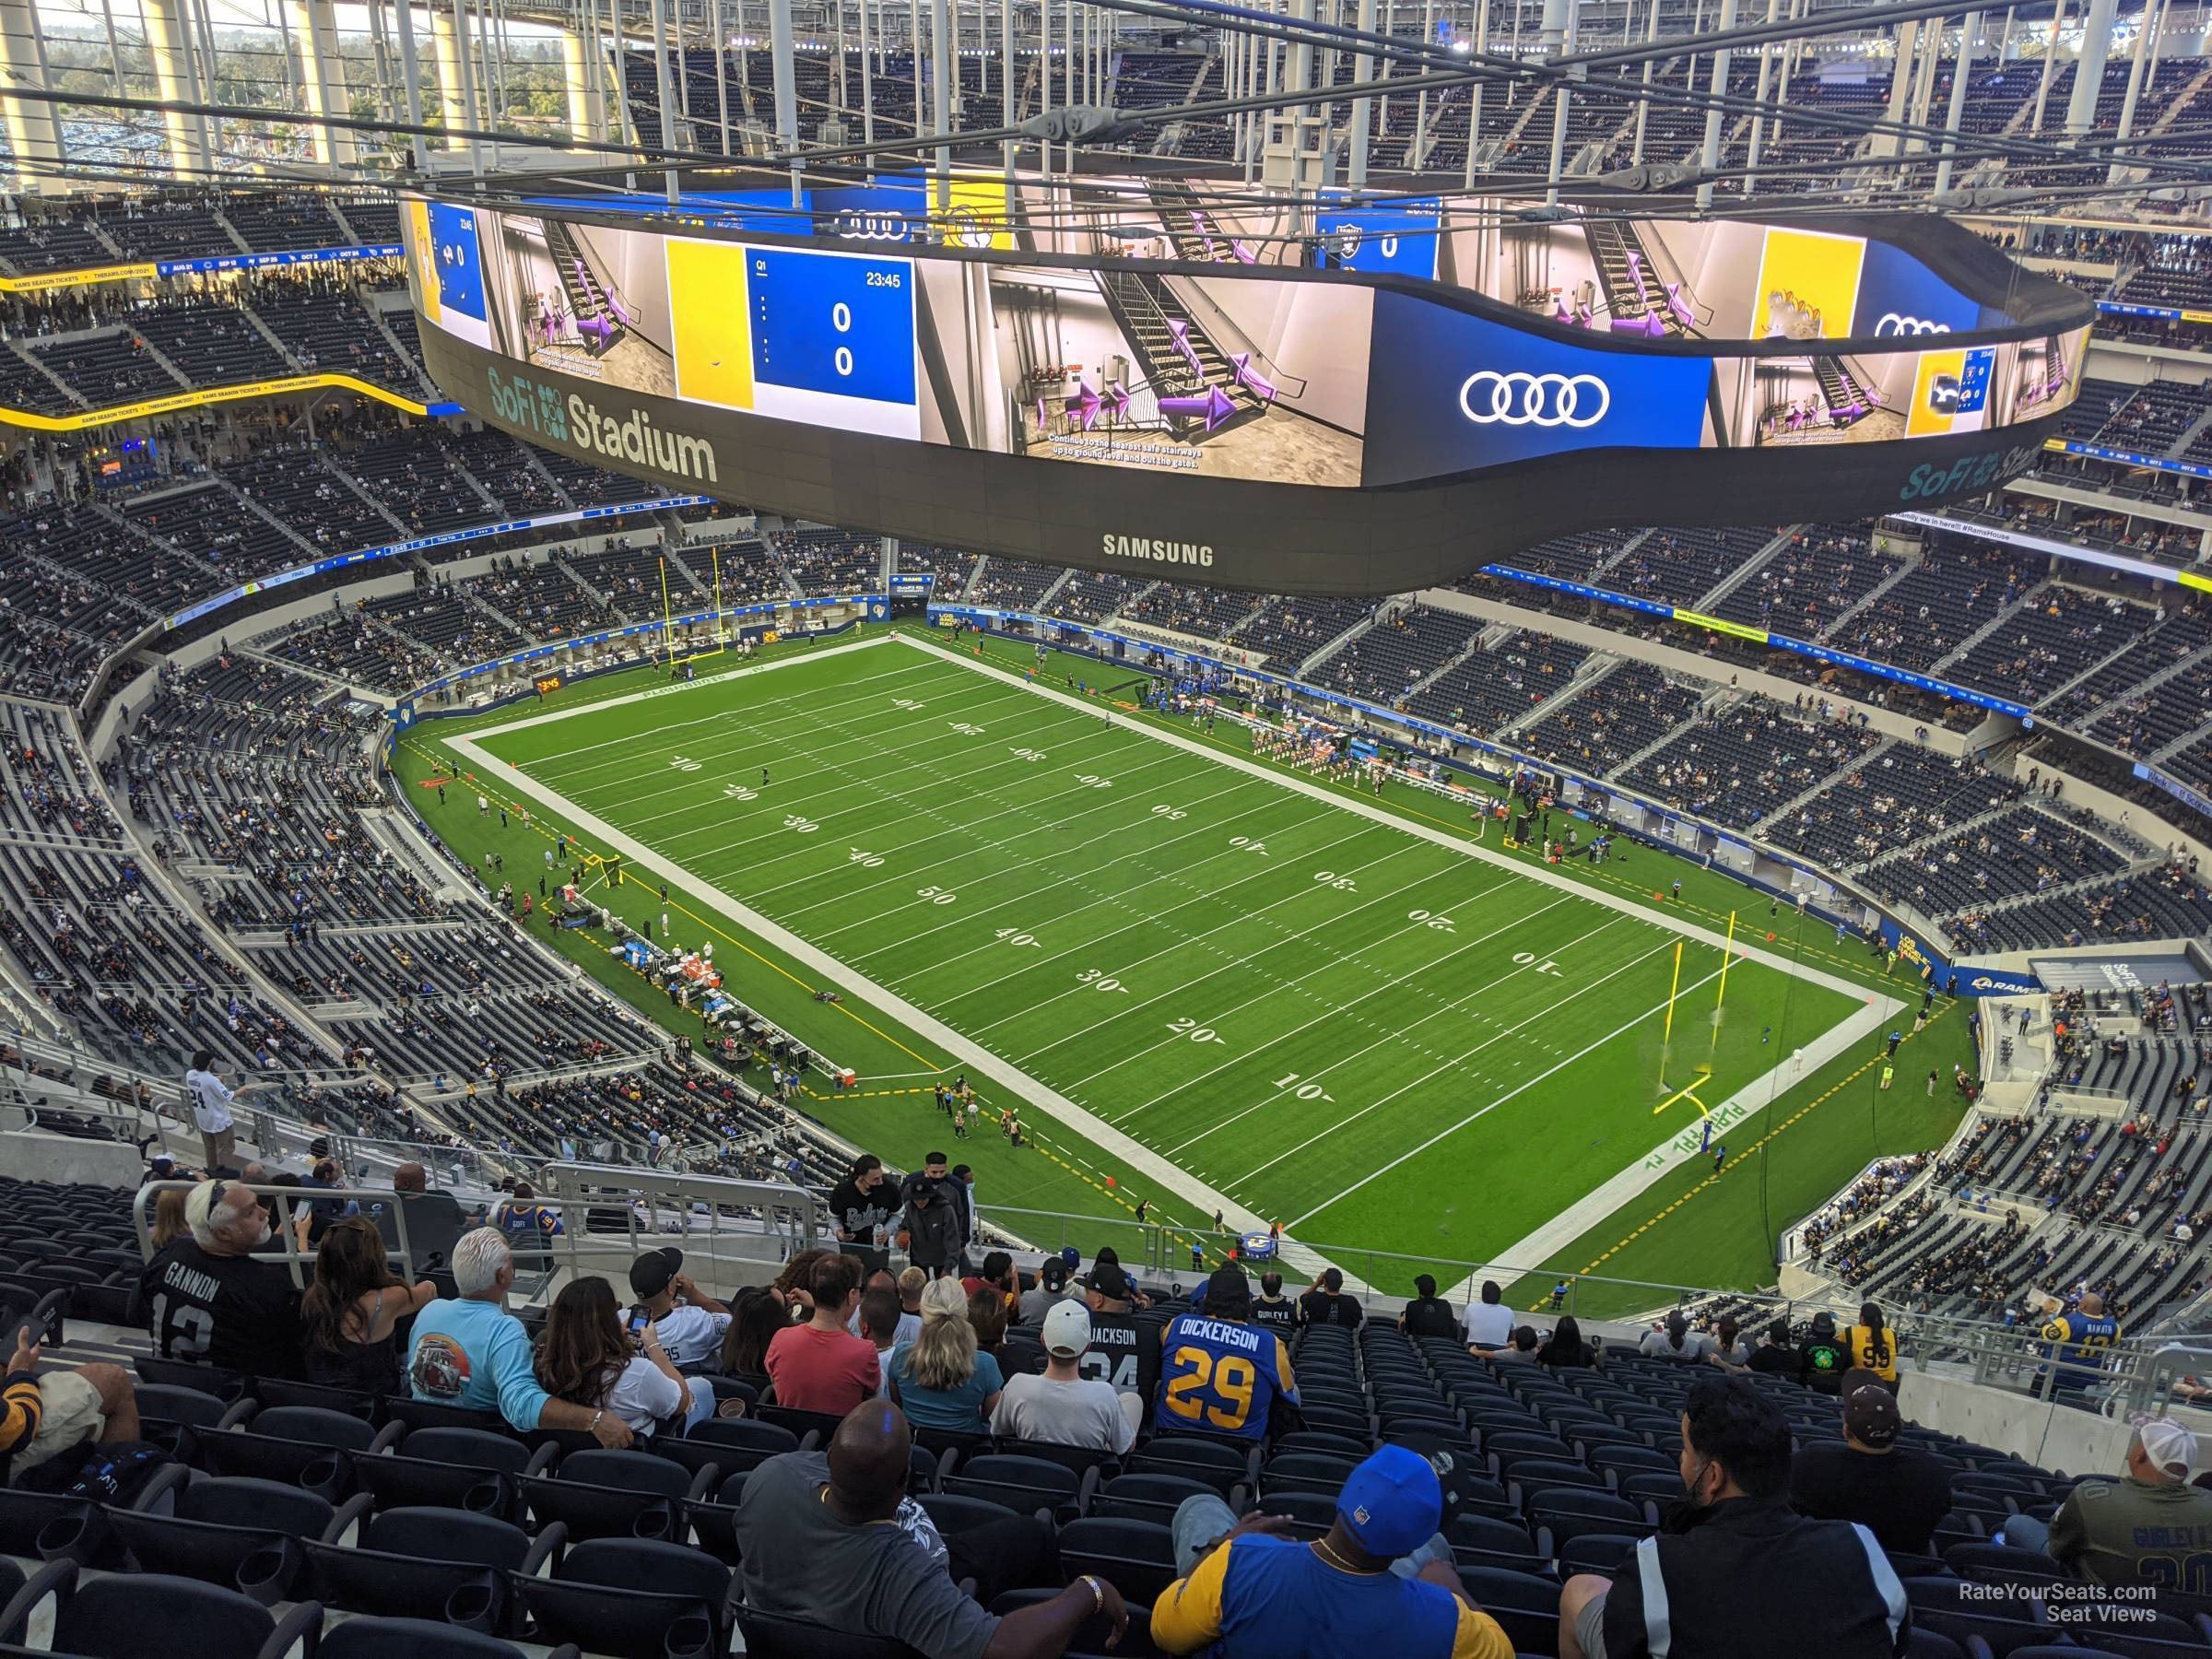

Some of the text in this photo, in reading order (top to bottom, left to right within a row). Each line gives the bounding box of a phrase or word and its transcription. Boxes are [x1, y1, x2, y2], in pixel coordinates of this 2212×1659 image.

[456, 244, 465, 266] 0
[1382, 233, 1399, 258] 0
[55, 276, 79, 284] TICKETS
[866, 271, 900, 288] 23:45
[832, 302, 851, 333] 0
[835, 347, 853, 376] 0
[488, 367, 717, 482] SoFi Stadium
[1048, 433, 1202, 458] Continue to the nearest safe stairways
[1053, 447, 1064, 455] up
[1075, 448, 1103, 460] ground
[1103, 451, 1124, 462] level
[1124, 453, 1140, 463] and
[1141, 455, 1157, 464] out
[1157, 456, 1171, 465] the
[1172, 459, 1198, 469] gates.
[1962, 525, 2009, 541] #RamsHouse
[1102, 534, 1214, 567] SAMSUNG
[764, 632, 776, 641] 25
[953, 722, 985, 736] 20
[670, 757, 702, 771] 10
[1014, 747, 1046, 762] 30
[1079, 774, 1113, 789] 40
[723, 785, 759, 801] 20
[1151, 805, 1187, 820] 50
[783, 816, 818, 833] 30
[1228, 836, 1264, 853] 40
[849, 850, 885, 867] 40
[1313, 871, 1356, 891] 30
[916, 886, 957, 905] 50
[1407, 910, 1453, 931] 20
[994, 927, 1034, 946] 40
[1900, 933, 1916, 947] LOS
[1512, 953, 1559, 973] 10
[1077, 970, 1121, 991] 30
[1992, 982, 2041, 994] RAMS
[1166, 1017, 1216, 1042] 20
[1272, 1072, 1323, 1100] 10
[164, 1261, 220, 1302] GANNON
[1258, 1311, 1283, 1321] GURLEY
[153, 1292, 214, 1366] 12
[1090, 1327, 1136, 1346] JACKSON
[1180, 1318, 1259, 1352] DICKERSON
[1863, 1346, 1890, 1369] 99
[1080, 1352, 1139, 1394] 34
[1165, 1346, 1255, 1430] 29
